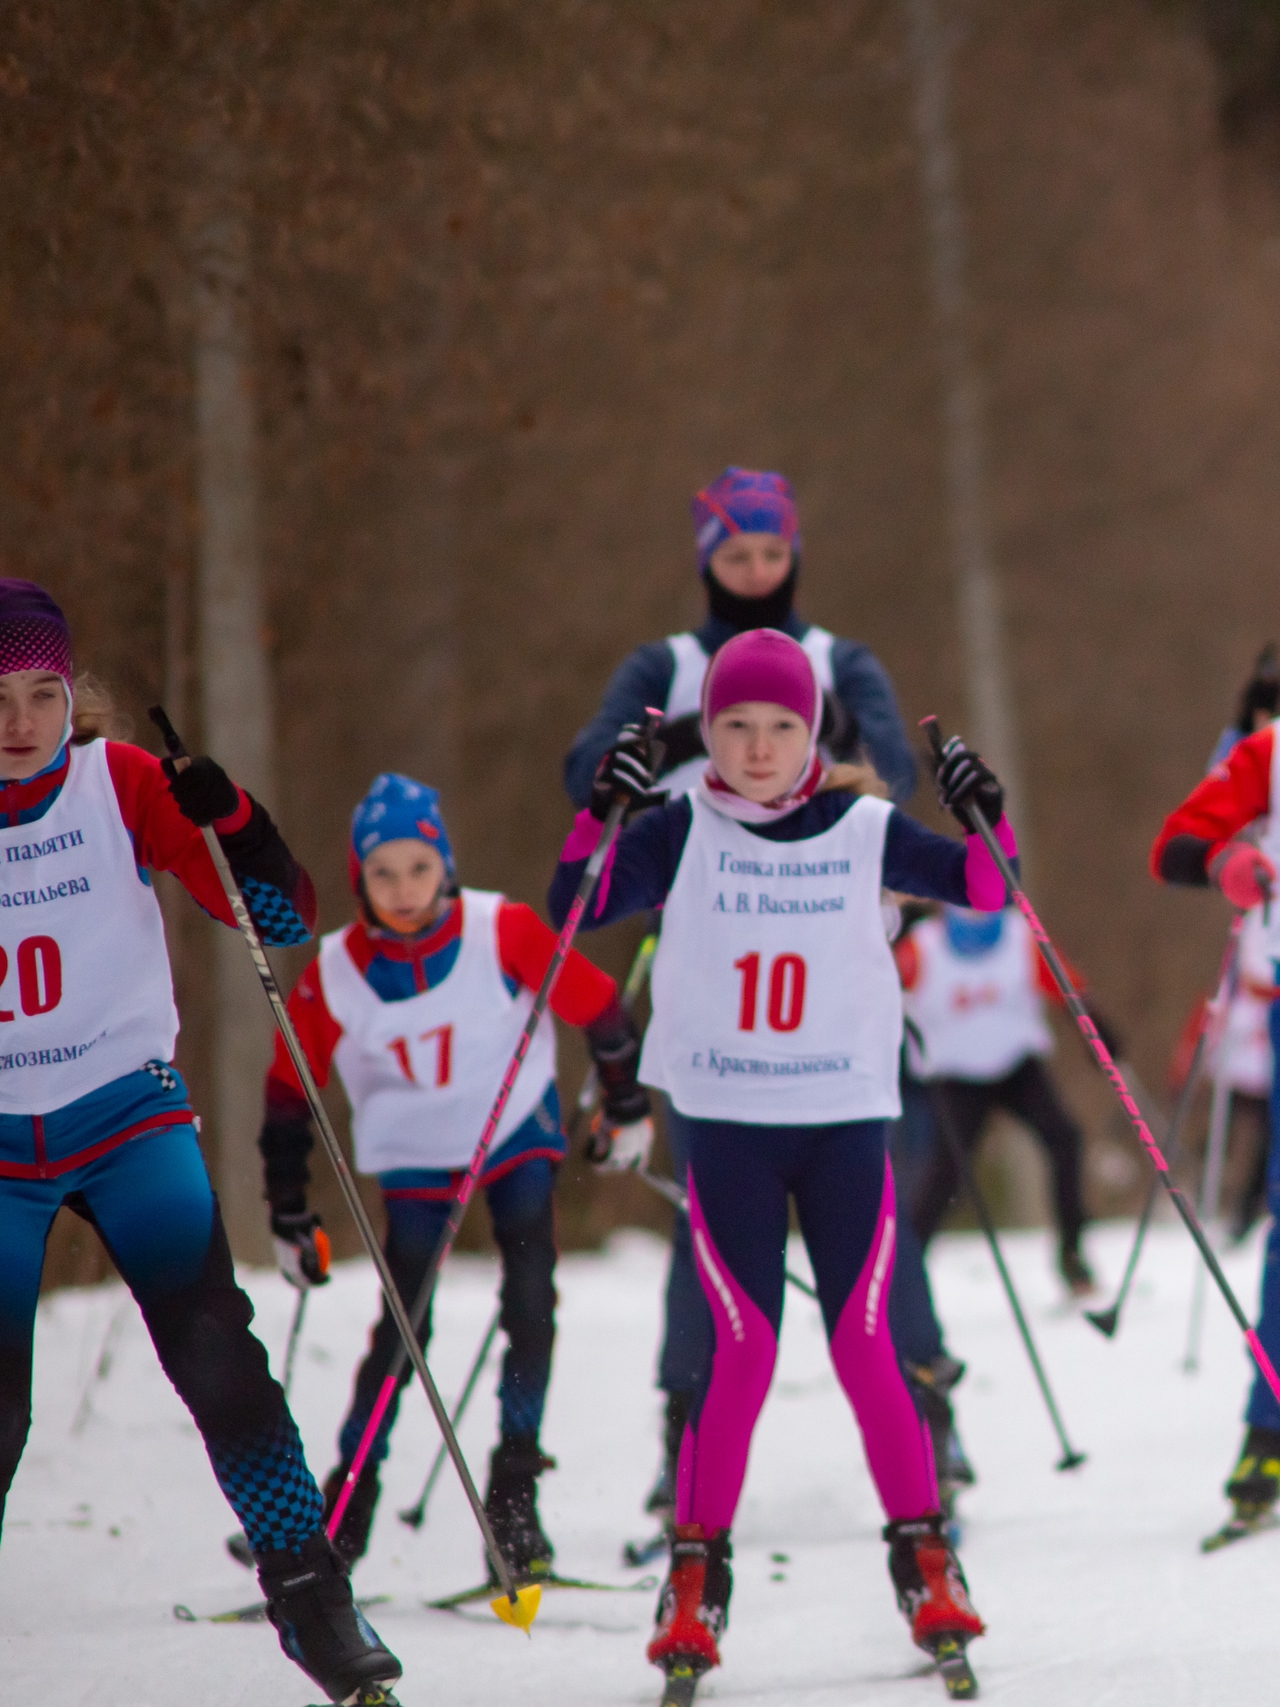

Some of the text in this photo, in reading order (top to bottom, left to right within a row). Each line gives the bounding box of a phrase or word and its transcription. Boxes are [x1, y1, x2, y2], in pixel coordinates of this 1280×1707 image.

[5, 829, 85, 862] памяти
[719, 851, 851, 877] Гонка памяти
[0, 876, 90, 908] асильева
[733, 950, 807, 1034] 10
[387, 1024, 455, 1090] 17
